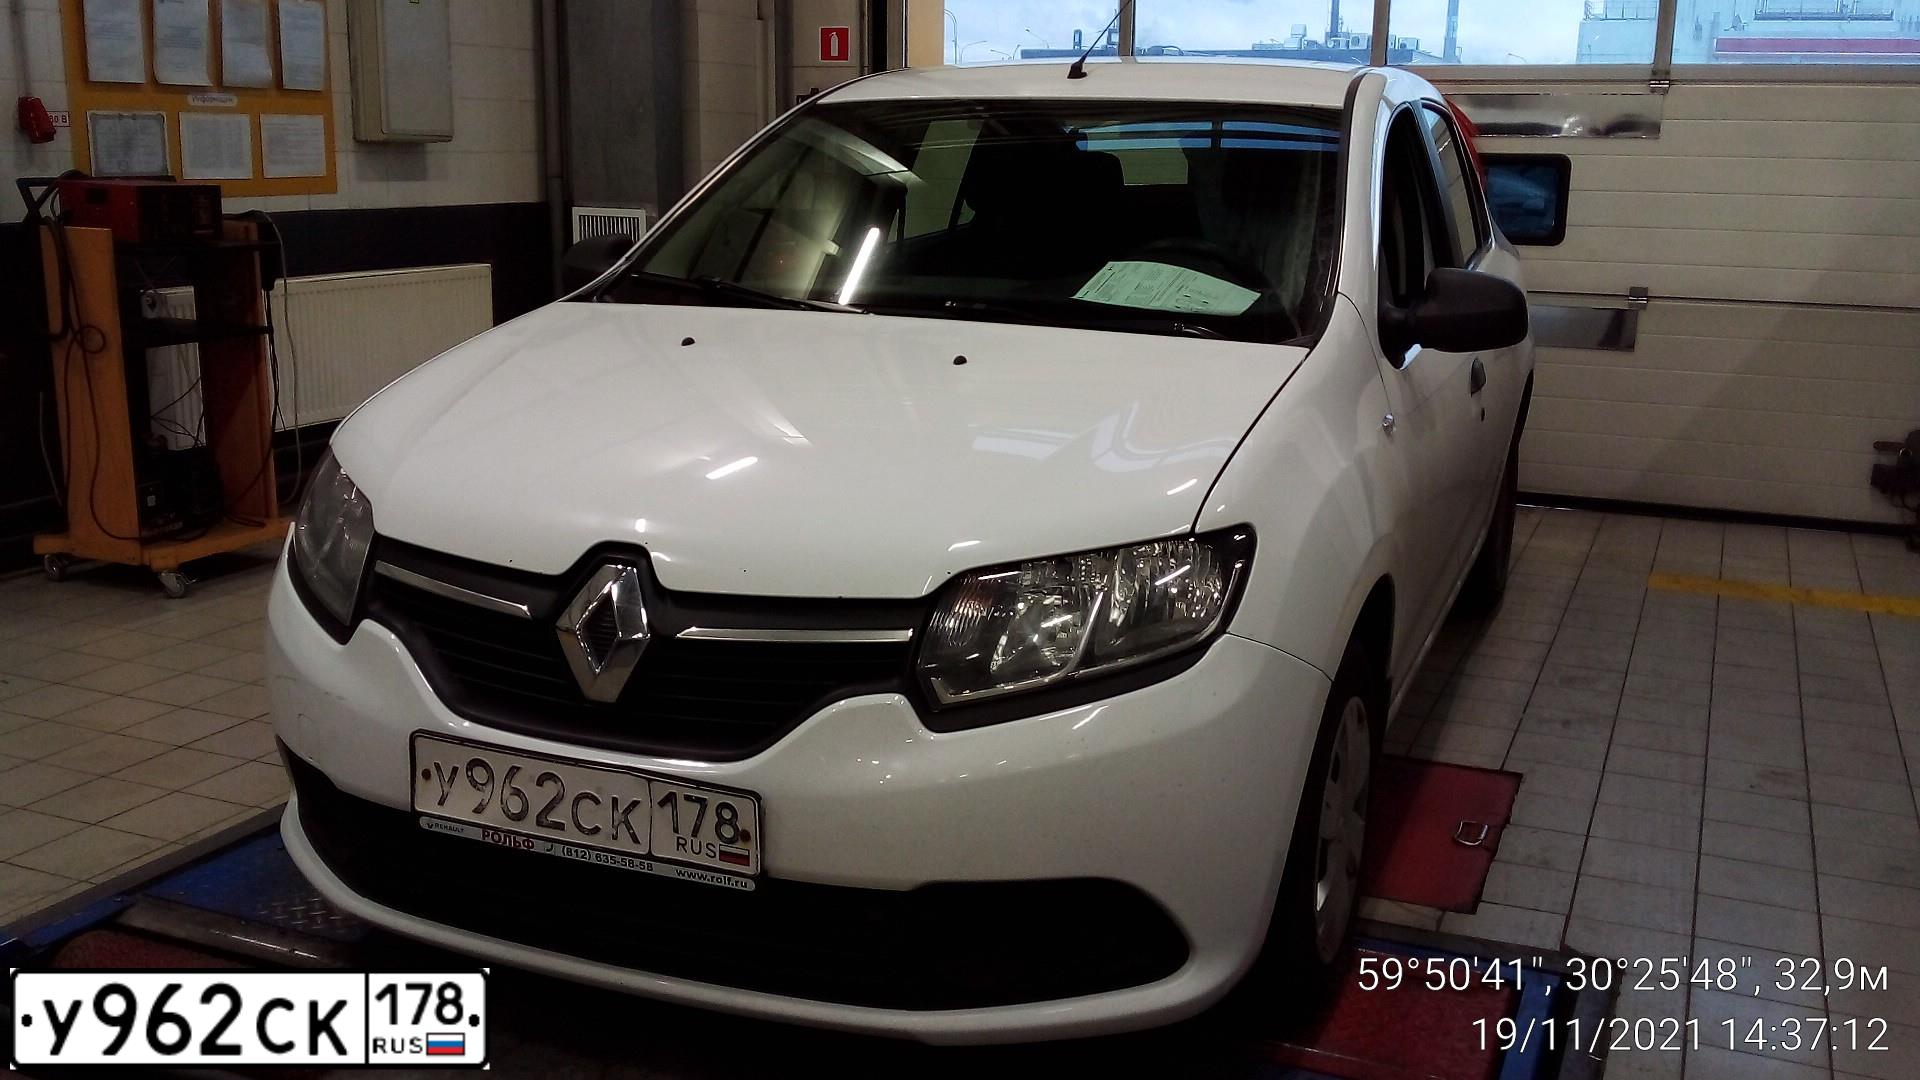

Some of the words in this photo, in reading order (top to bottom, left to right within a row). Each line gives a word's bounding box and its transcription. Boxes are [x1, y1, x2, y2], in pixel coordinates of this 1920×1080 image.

[433, 757, 642, 845] У962СК
[434, 822, 465, 834] RENAULT
[657, 791, 740, 845] 178
[481, 829, 535, 850] РОЛЬФ
[676, 836, 718, 859] RUS
[561, 845, 592, 861] (812)
[595, 854, 654, 872] 635-58-58
[675, 869, 748, 889] www.rolf.ru
